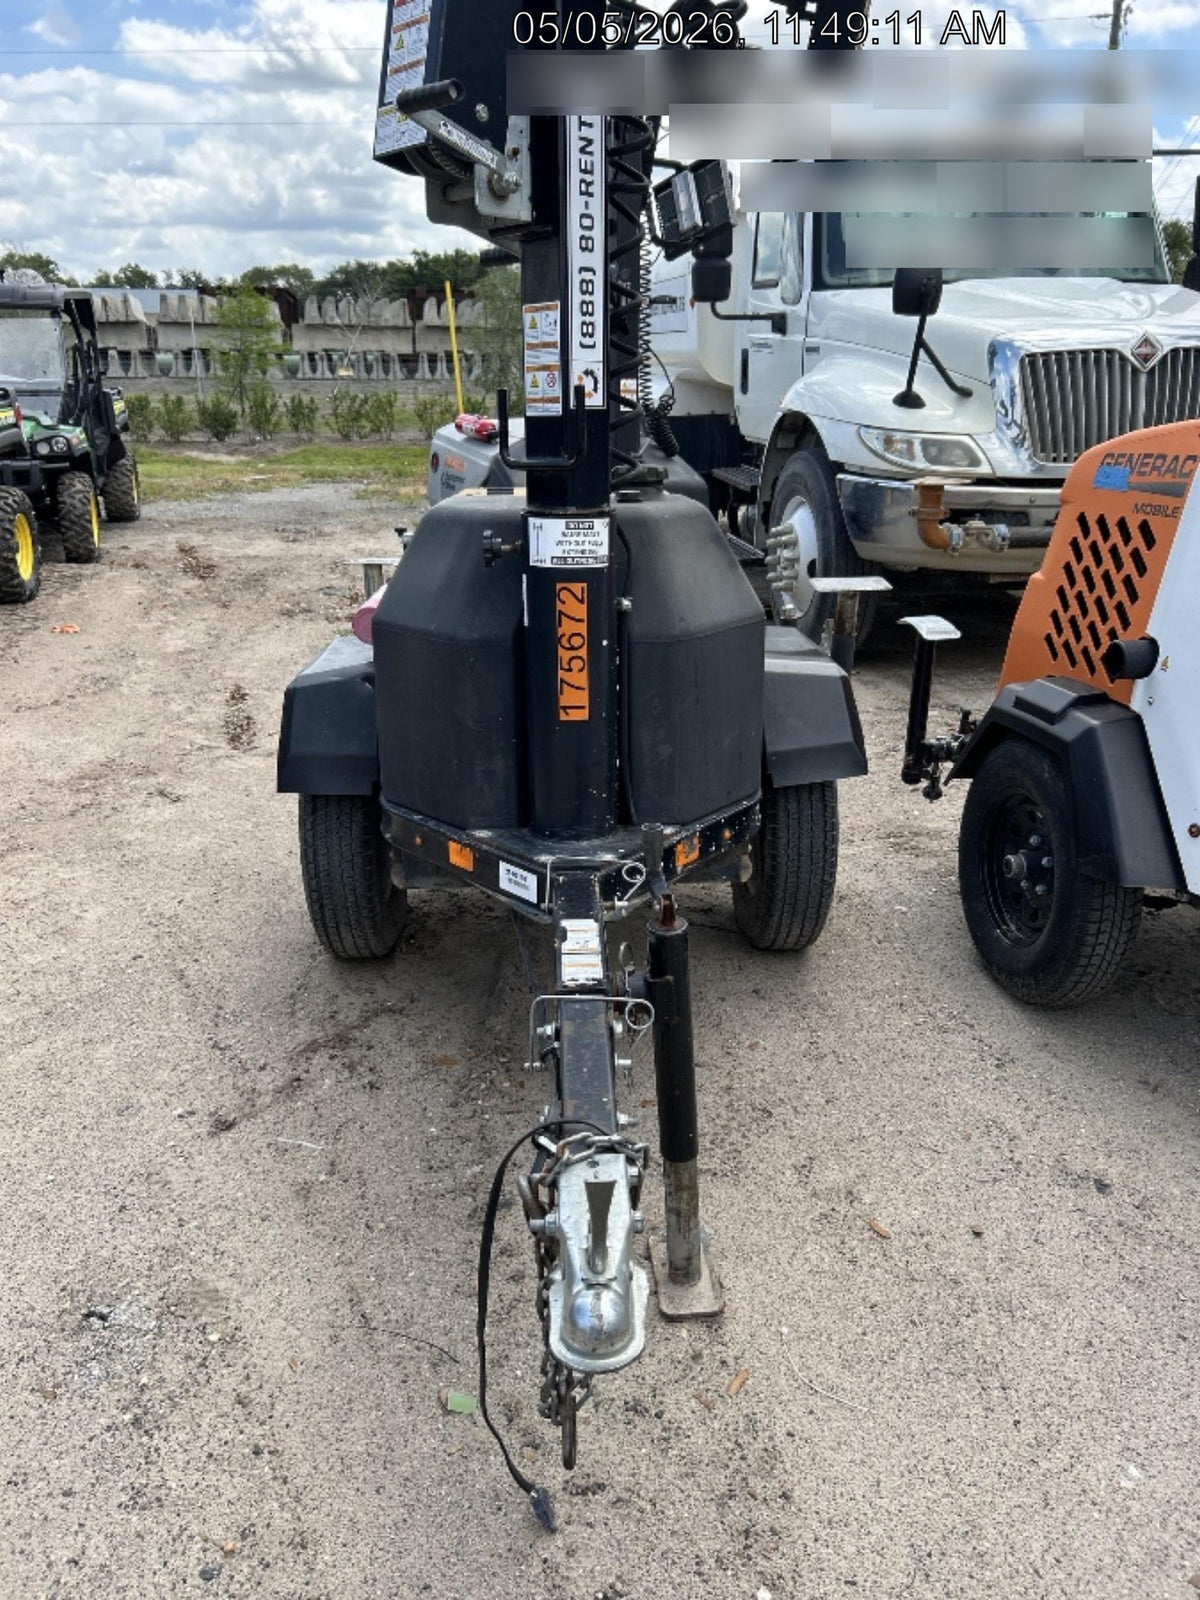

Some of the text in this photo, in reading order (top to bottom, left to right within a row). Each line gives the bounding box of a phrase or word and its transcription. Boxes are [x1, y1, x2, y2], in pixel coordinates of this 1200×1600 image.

[579, 266, 597, 350] (888)
[1133, 503, 1180, 517] MOBILE
[558, 586, 587, 717] 175672
